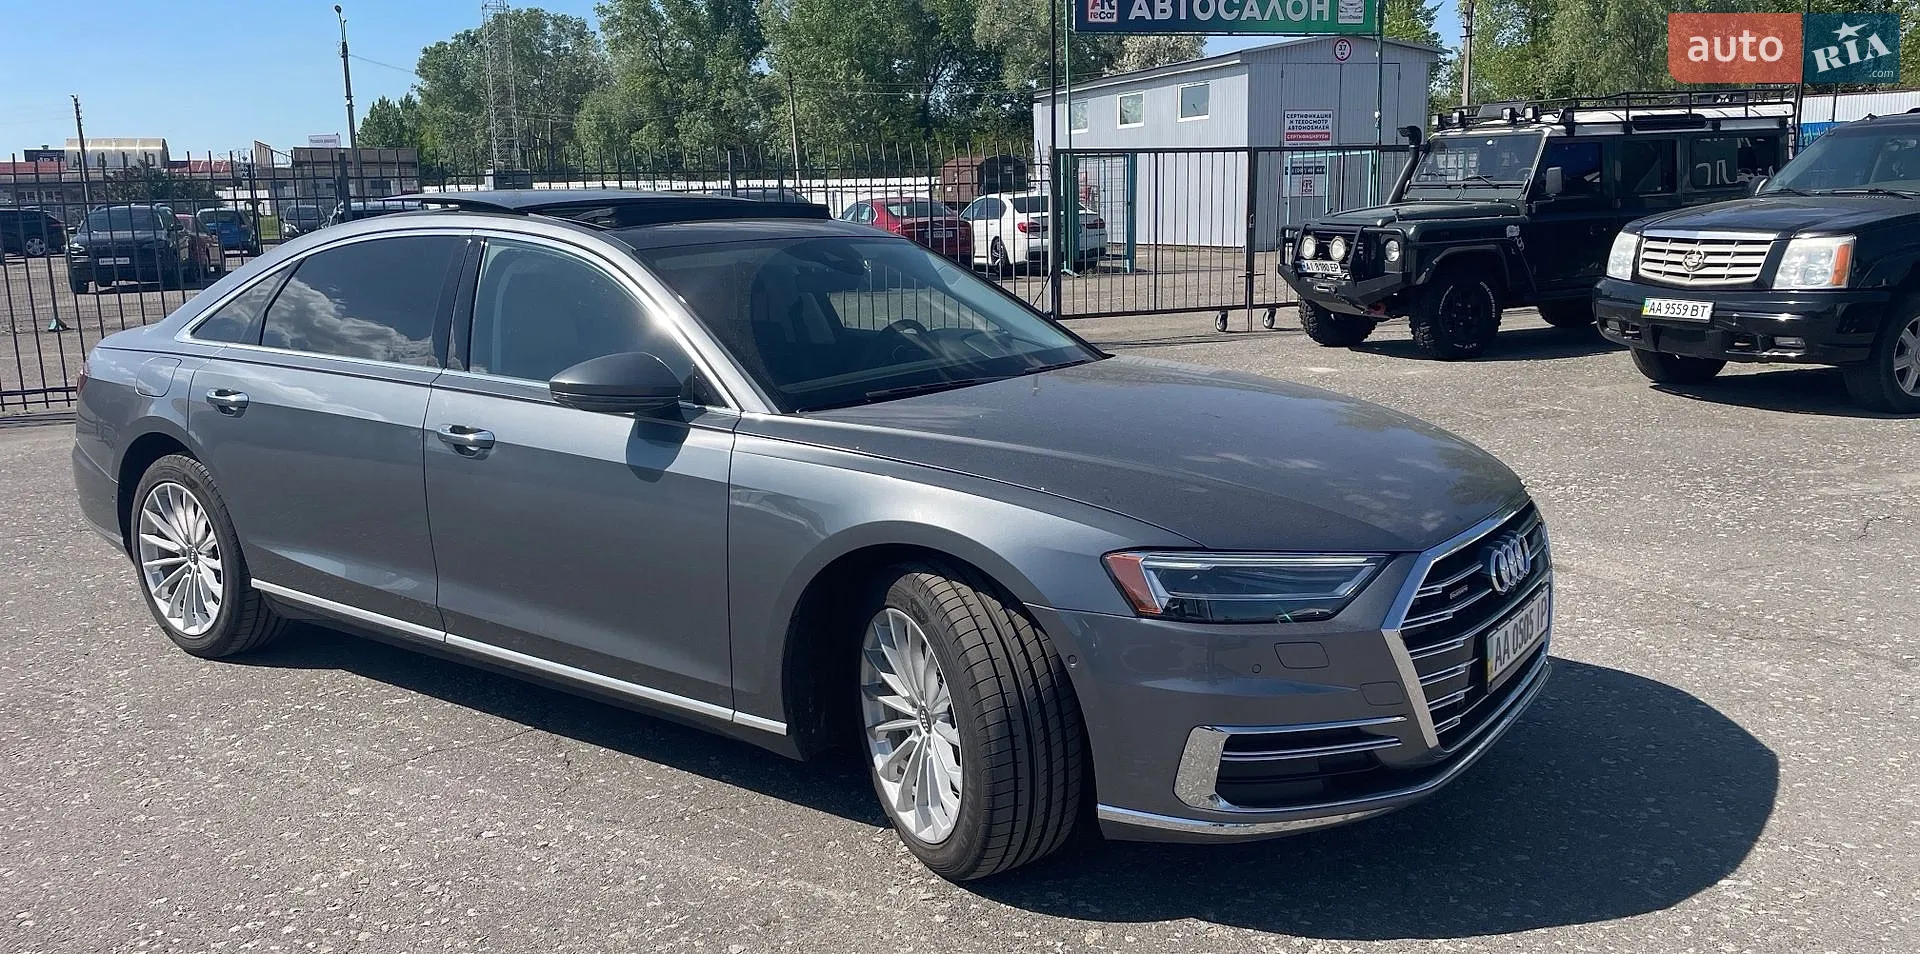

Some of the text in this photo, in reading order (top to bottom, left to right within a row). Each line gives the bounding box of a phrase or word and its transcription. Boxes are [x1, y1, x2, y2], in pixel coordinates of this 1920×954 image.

[1128, 0, 1329, 21] АВТОСАЛОН
[1649, 301, 1708, 317] AA 9559 BT
[1494, 596, 1548, 672] AA 0505 IP
